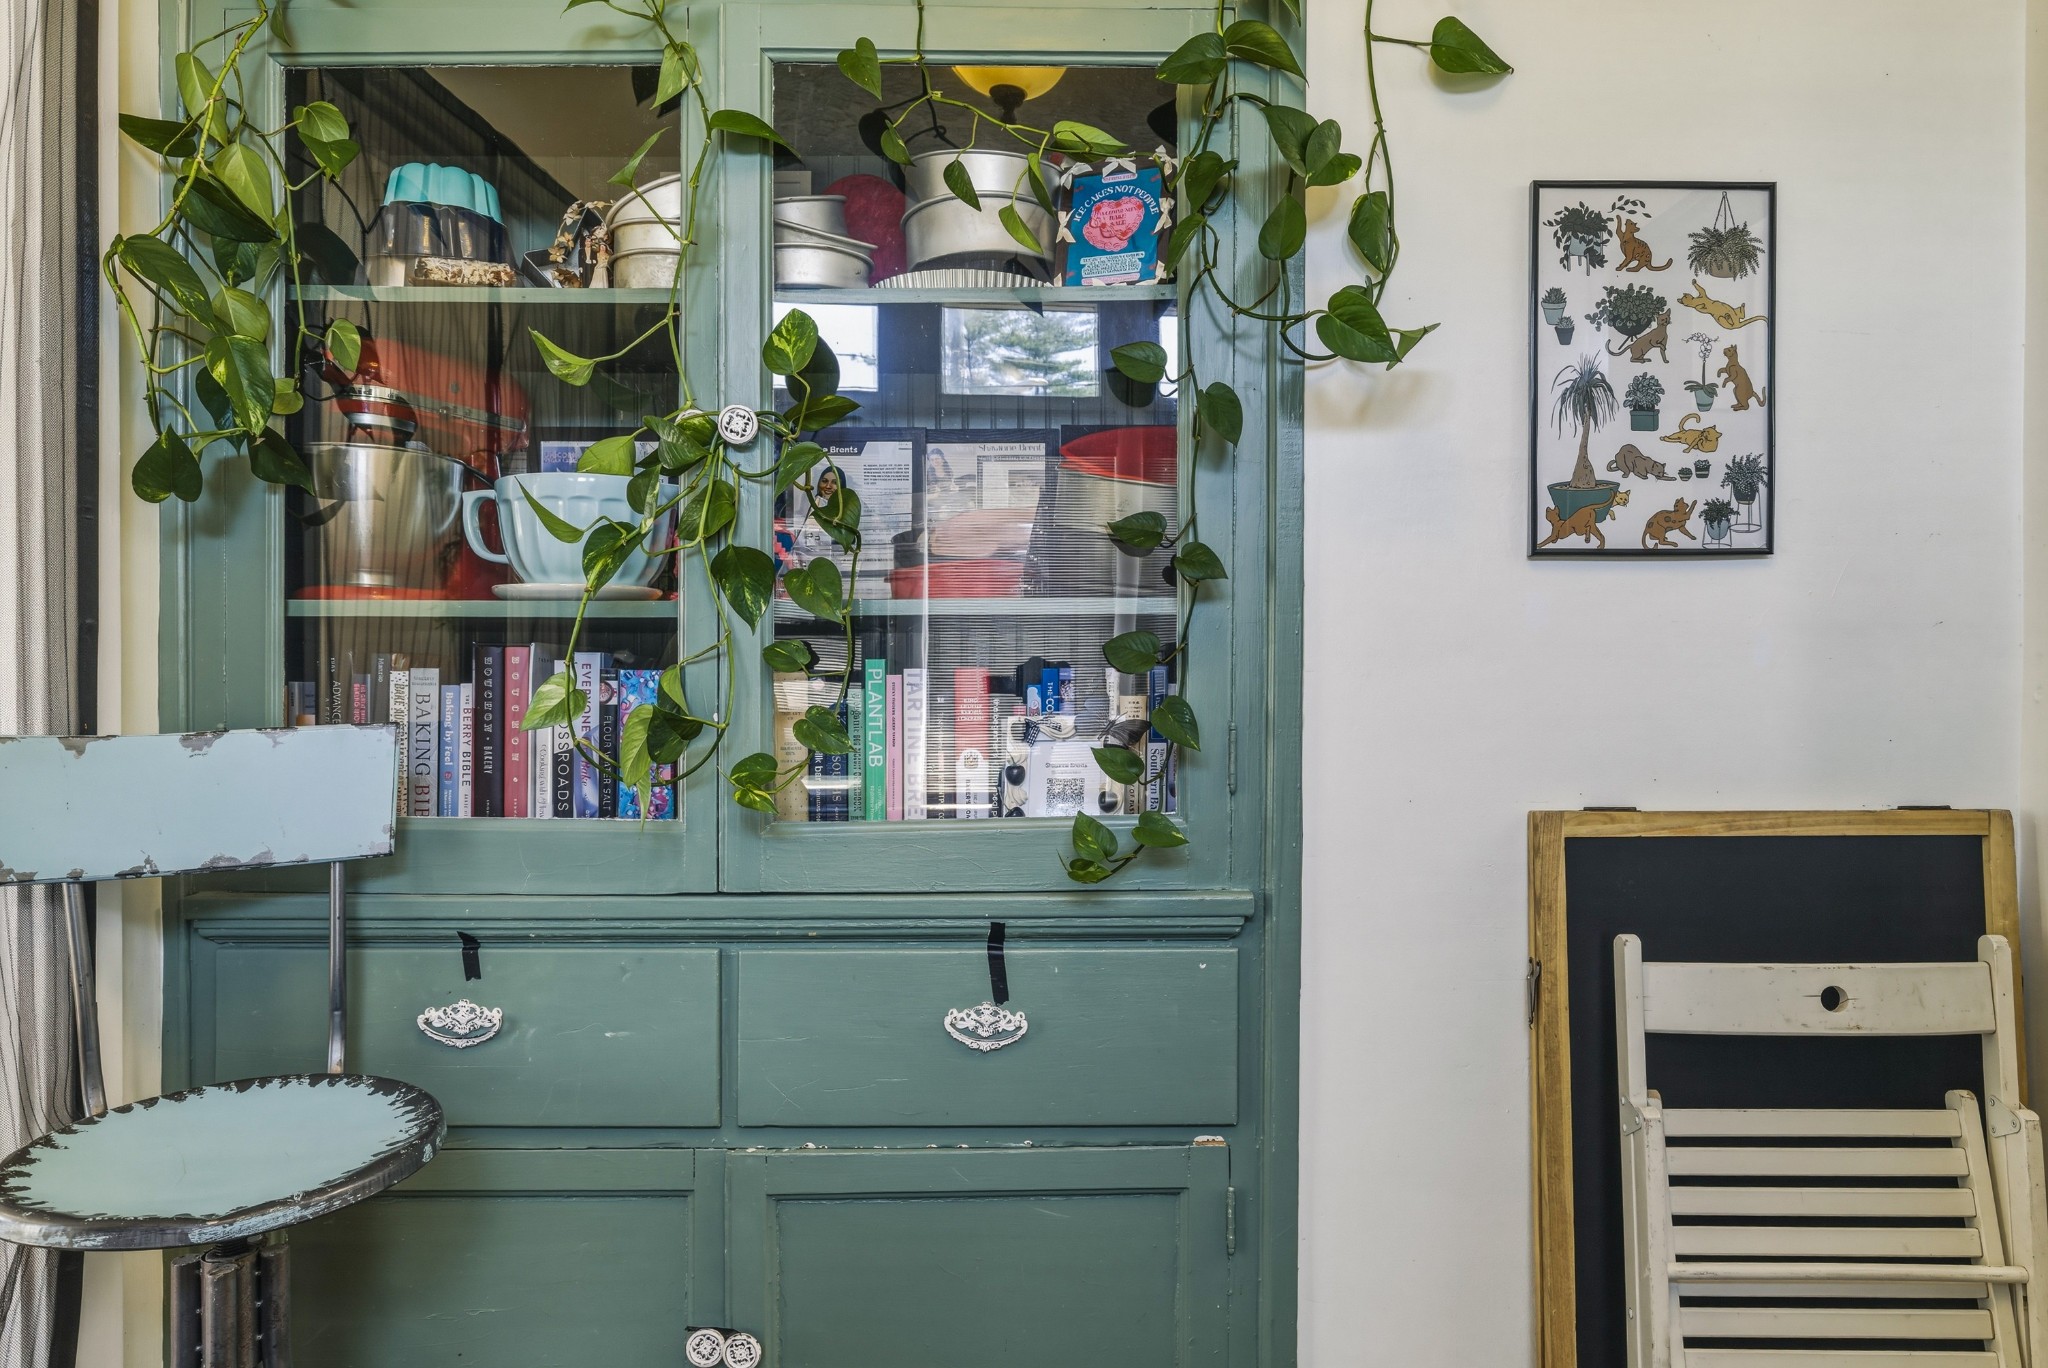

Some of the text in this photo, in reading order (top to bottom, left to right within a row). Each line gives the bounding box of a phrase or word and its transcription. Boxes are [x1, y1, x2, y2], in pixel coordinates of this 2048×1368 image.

[1073, 205, 1086, 222] ICE
[1085, 186, 1114, 208] CAKES
[1114, 185, 1136, 194] NOT
[1134, 187, 1159, 215] PEOPLE
[830, 445, 858, 454] Brents
[462, 707, 471, 746] BERRY
[483, 656, 493, 775] BOUCHON BAKERY
[511, 656, 520, 762] BOUCHON
[867, 668, 883, 768] PLANTLAB
[906, 669, 923, 769] TARTINE
[414, 692, 431, 776] BAKING
[443, 692, 454, 766] Baking by Feel
[603, 715, 612, 748] FLOUR
[462, 751, 471, 787] BIBLE
[538, 744, 547, 779] Cooking
[814, 765, 824, 782] bar
[539, 780, 548, 795] with
[603, 788, 612, 810] SALT
[906, 773, 923, 821] BRE
